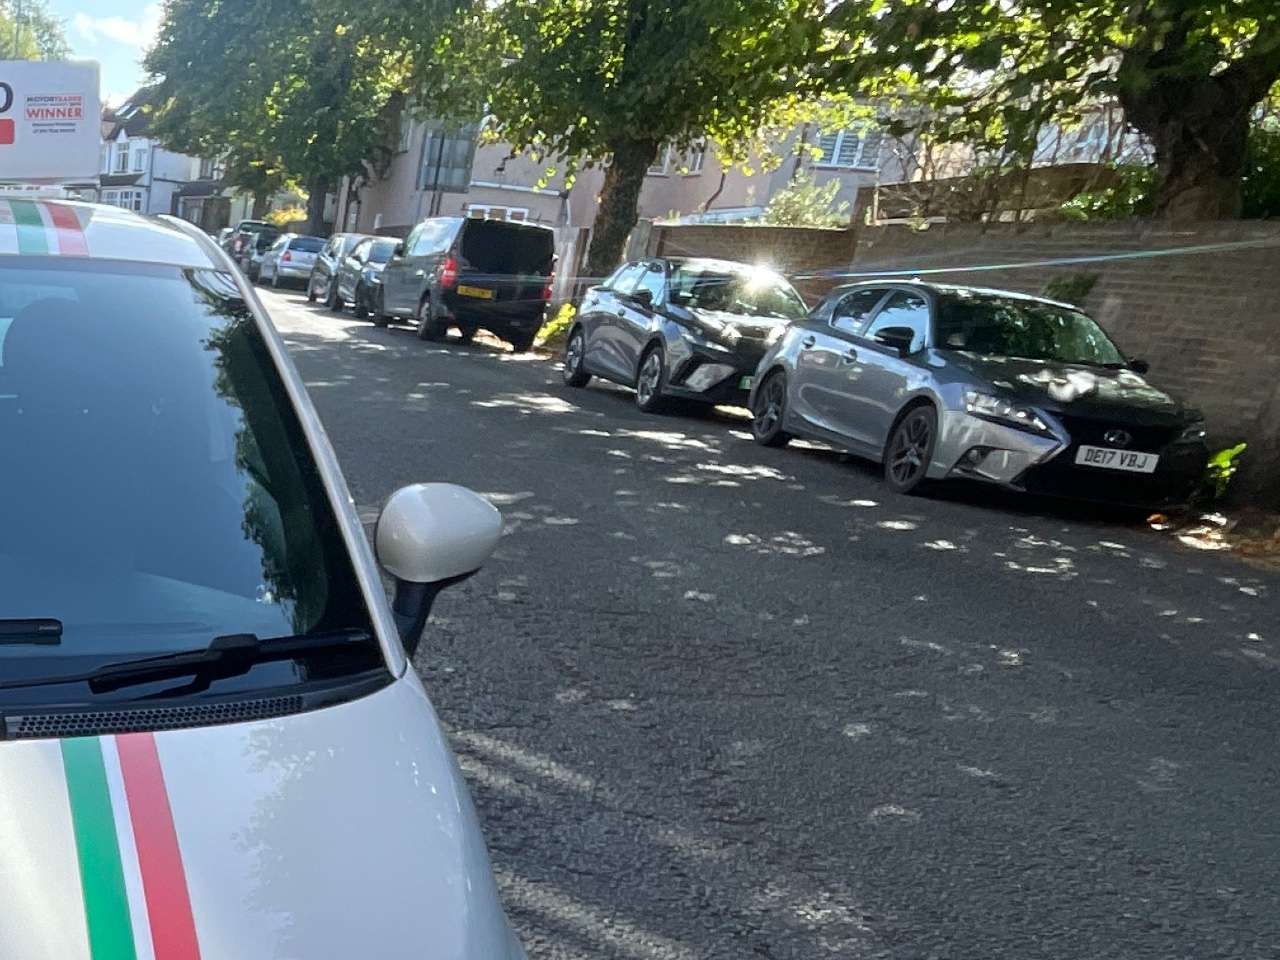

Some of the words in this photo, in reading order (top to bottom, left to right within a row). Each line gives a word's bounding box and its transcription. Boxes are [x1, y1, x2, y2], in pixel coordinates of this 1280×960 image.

[26, 107, 82, 118] WINNER
[1084, 449, 1117, 464] DE17
[1120, 452, 1148, 468] VBJ
